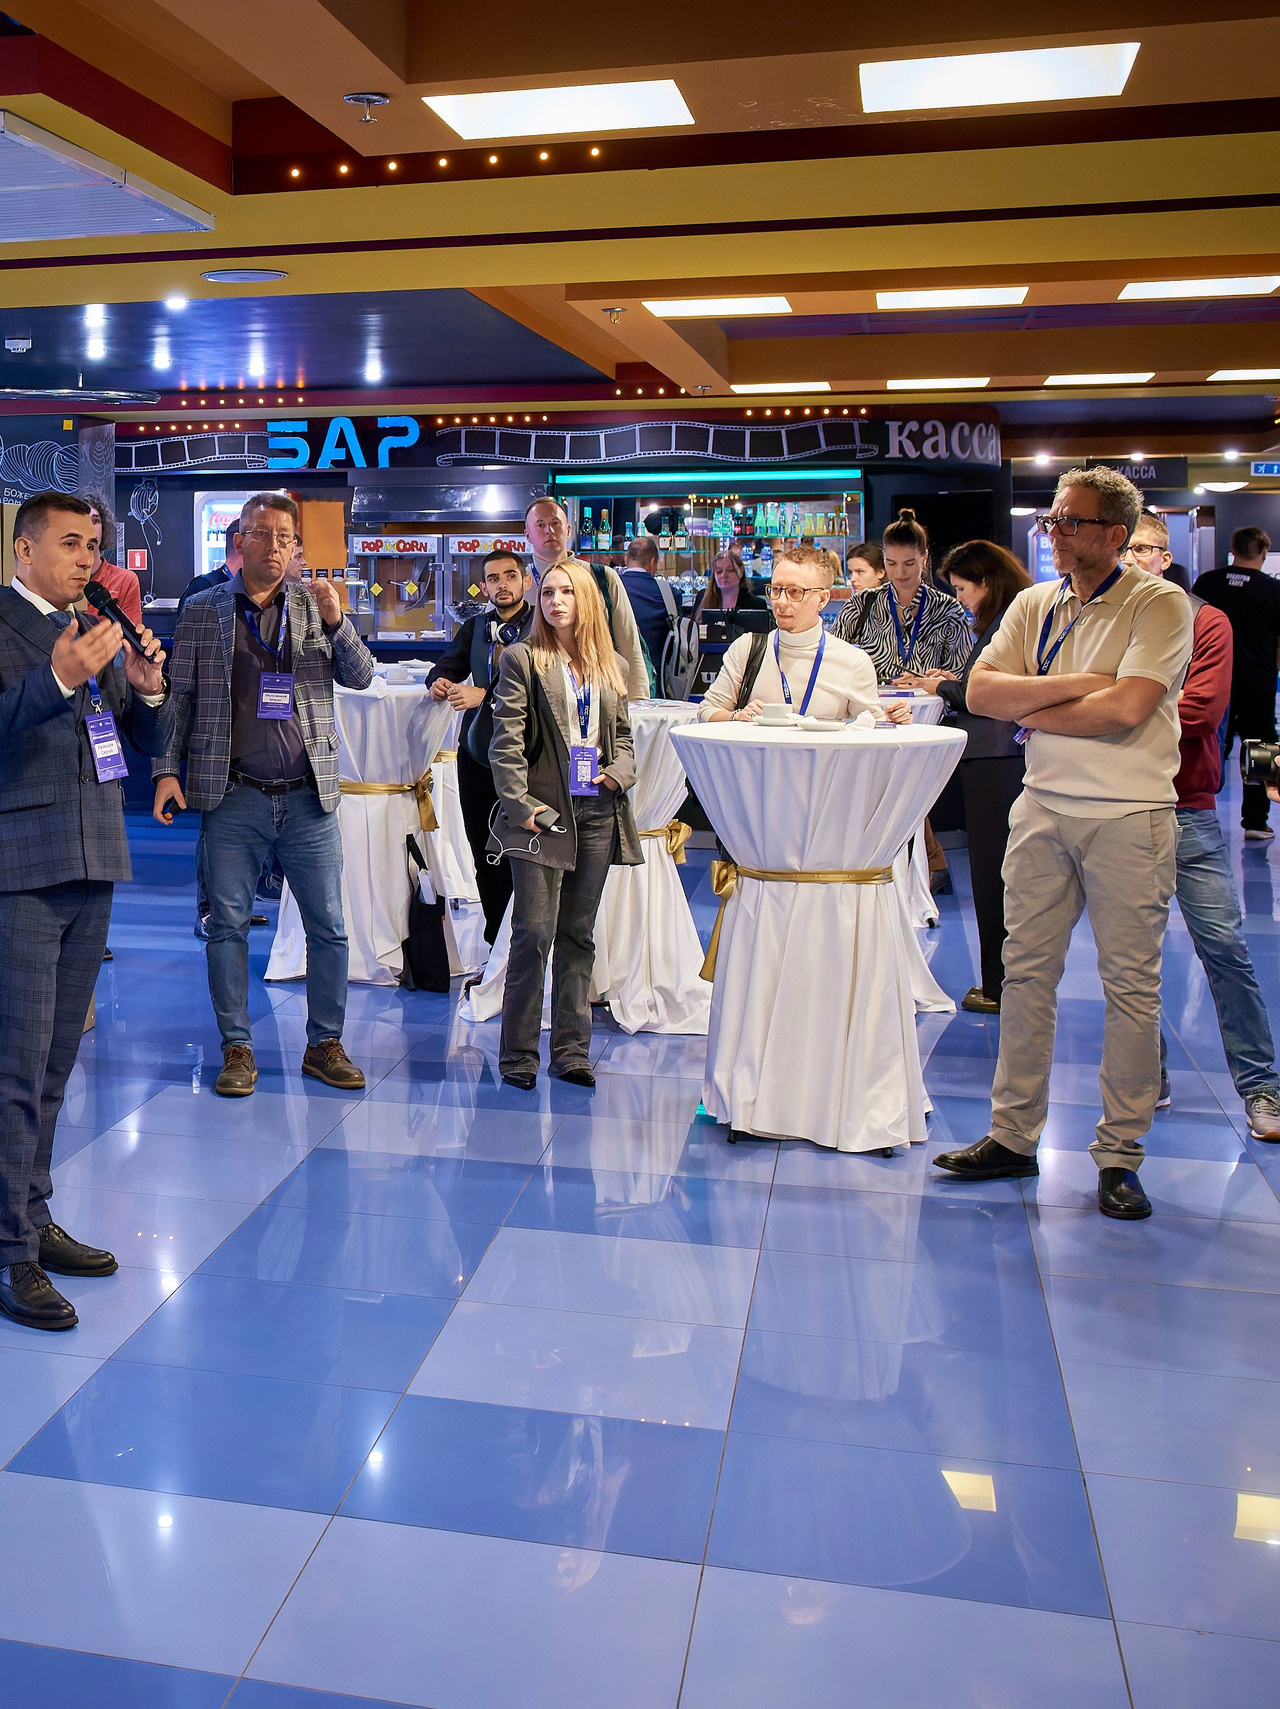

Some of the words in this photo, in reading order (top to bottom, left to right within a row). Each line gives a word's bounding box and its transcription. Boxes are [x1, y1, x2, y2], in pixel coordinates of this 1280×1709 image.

[267, 416, 420, 468] БАР
[885, 419, 998, 460] касса
[361, 539, 384, 552] POP
[396, 539, 428, 552] CORN
[457, 539, 480, 552] POP
